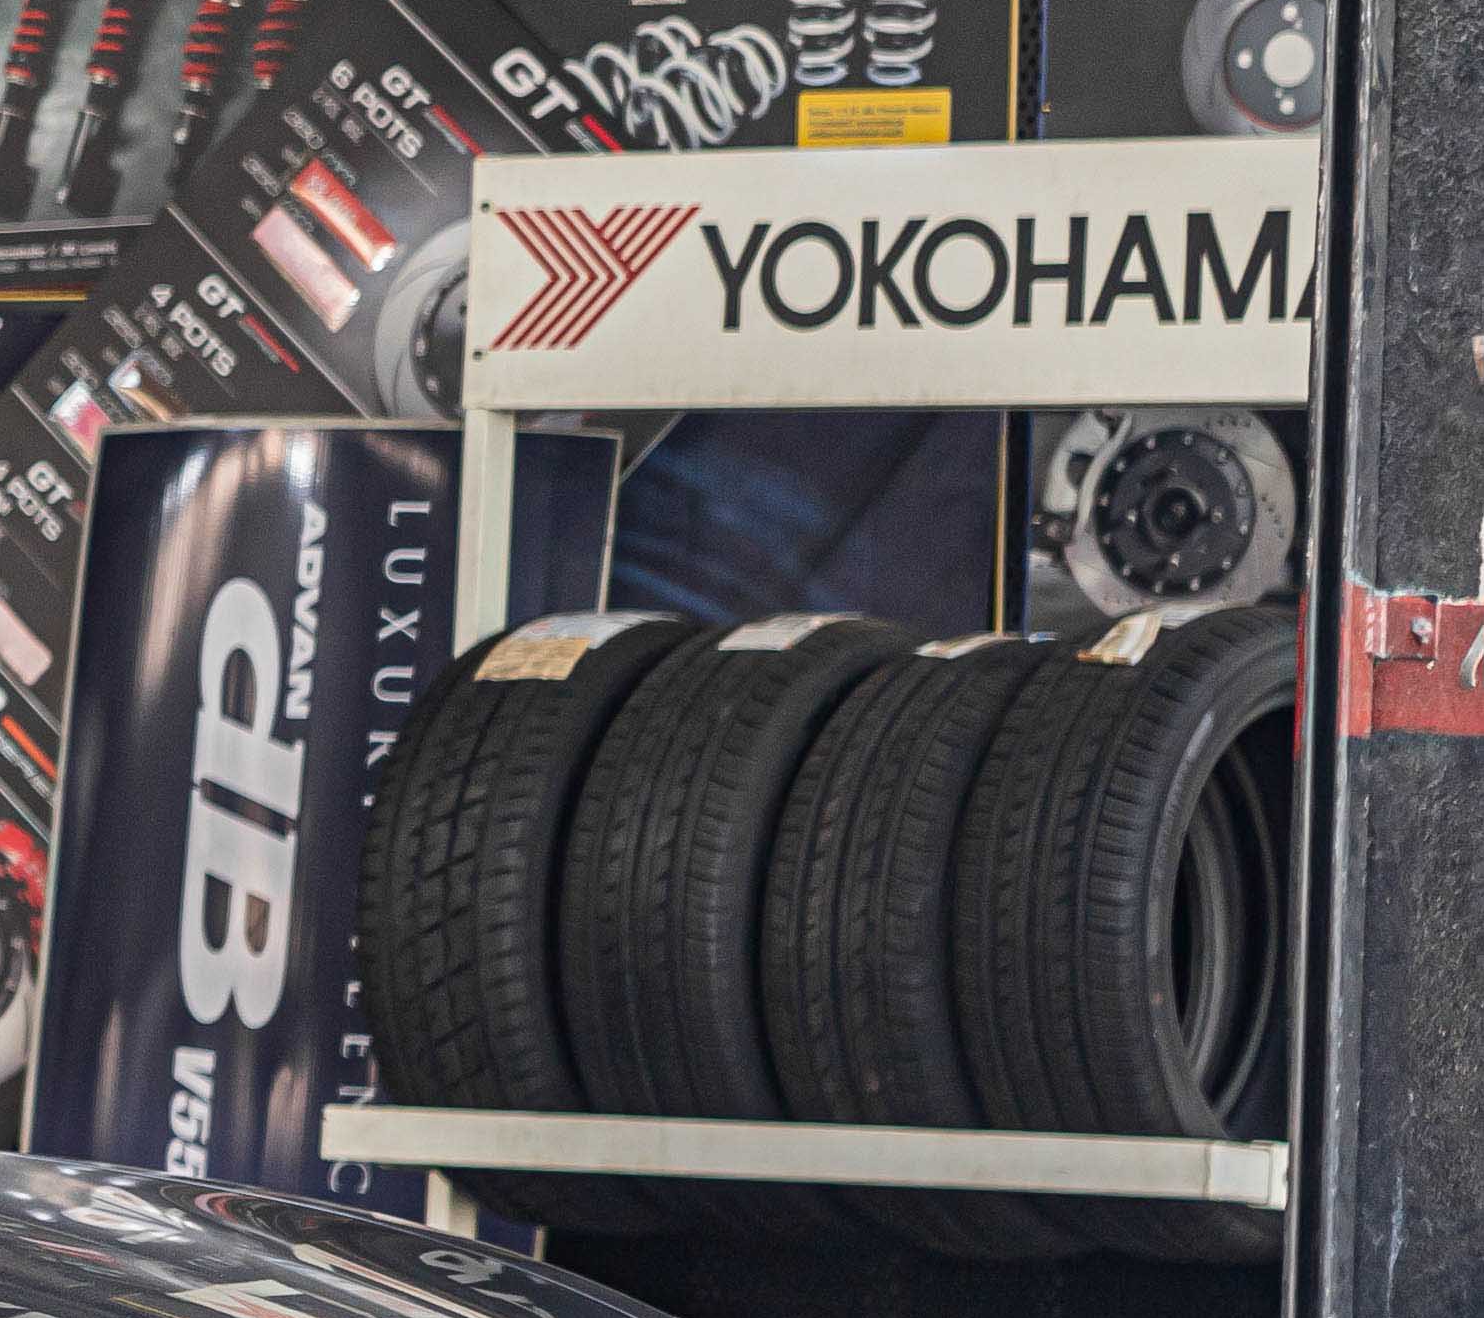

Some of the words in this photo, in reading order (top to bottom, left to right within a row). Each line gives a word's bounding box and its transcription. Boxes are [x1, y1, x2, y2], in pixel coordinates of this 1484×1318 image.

[351, 77, 425, 159] POTS
[381, 64, 431, 119] GT
[492, 48, 582, 122] GT
[196, 273, 243, 321] GT
[701, 209, 1316, 333] YOKOHAM
[27, 460, 73, 507] GT
[286, 502, 330, 722] ADVAN
[365, 500, 430, 806] LUXUR
[180, 578, 305, 1029] dB
[166, 1047, 218, 1180] V55
